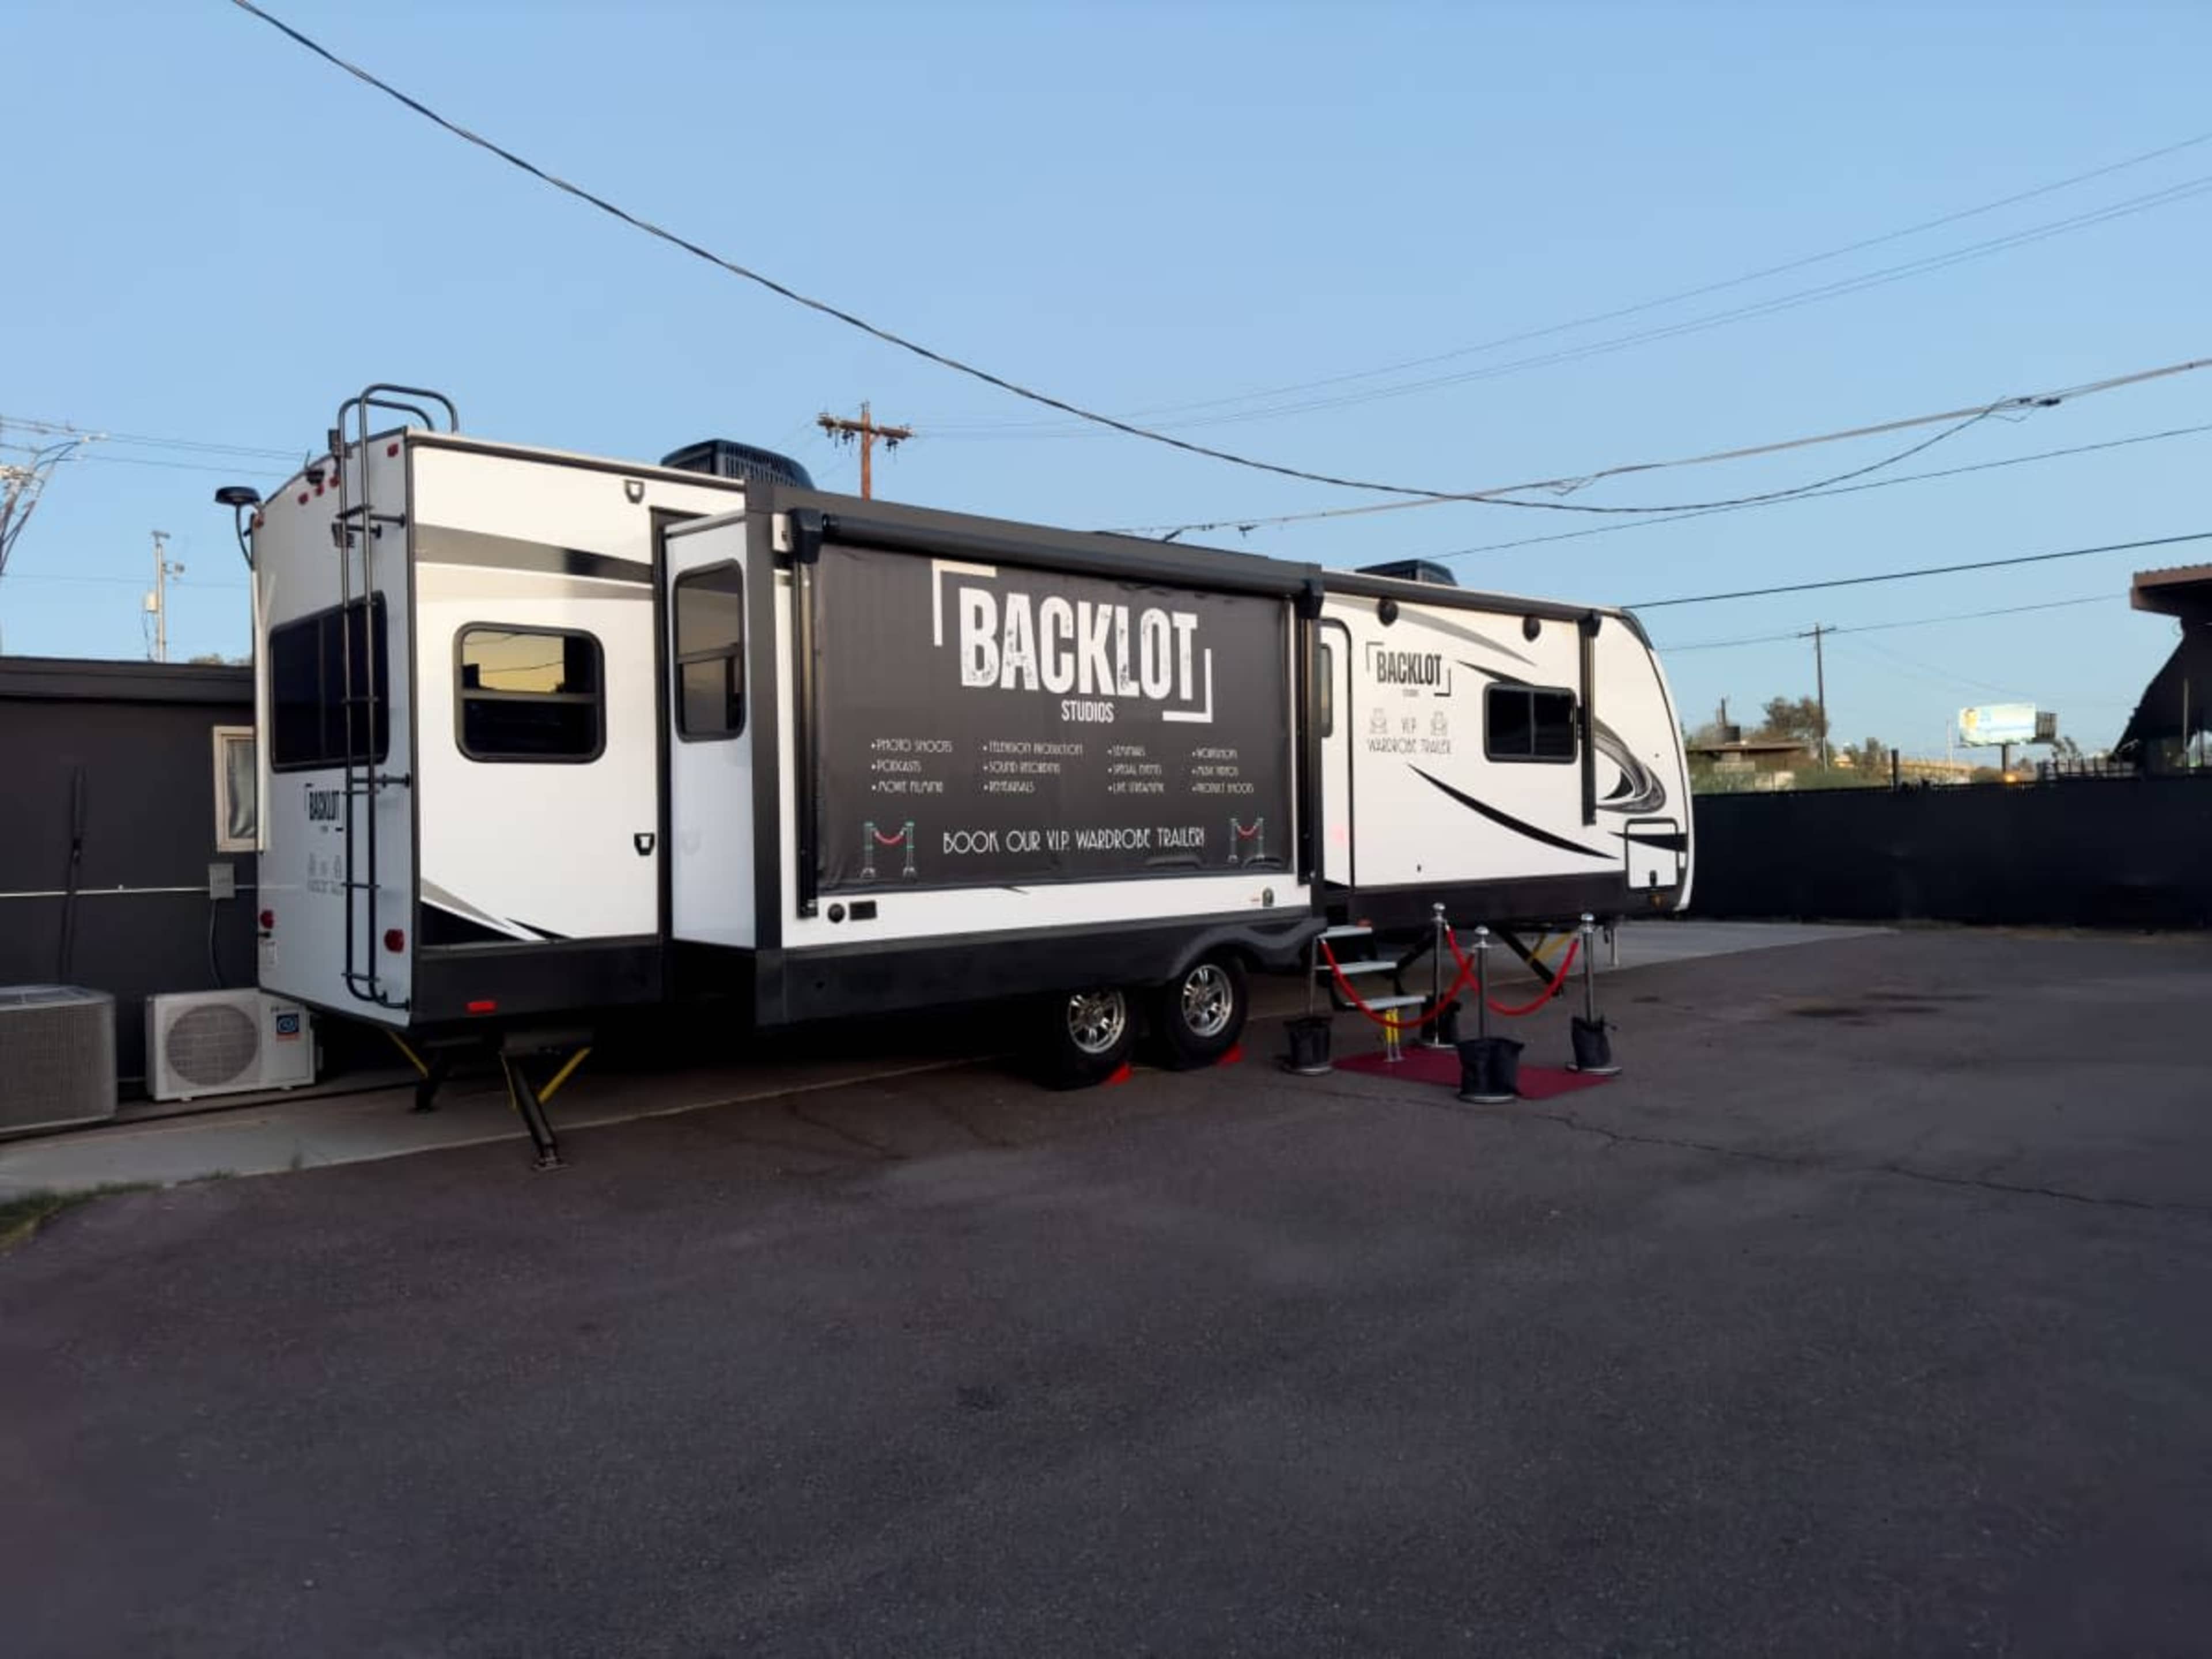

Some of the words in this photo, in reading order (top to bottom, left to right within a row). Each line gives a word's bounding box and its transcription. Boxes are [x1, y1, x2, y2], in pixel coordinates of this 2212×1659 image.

[959, 586, 1198, 700] BACKLOT
[1376, 650, 1442, 686] BACKLOT
[1061, 699, 1115, 723] STUDIOS
[876, 738, 911, 752] PHOTO
[914, 739, 953, 753] SHOOTS
[877, 759, 921, 772] PODCASTS
[942, 830, 1000, 854] BOOK
[1006, 830, 1041, 853] OUR
[1075, 827, 1152, 850] WARDROBE
